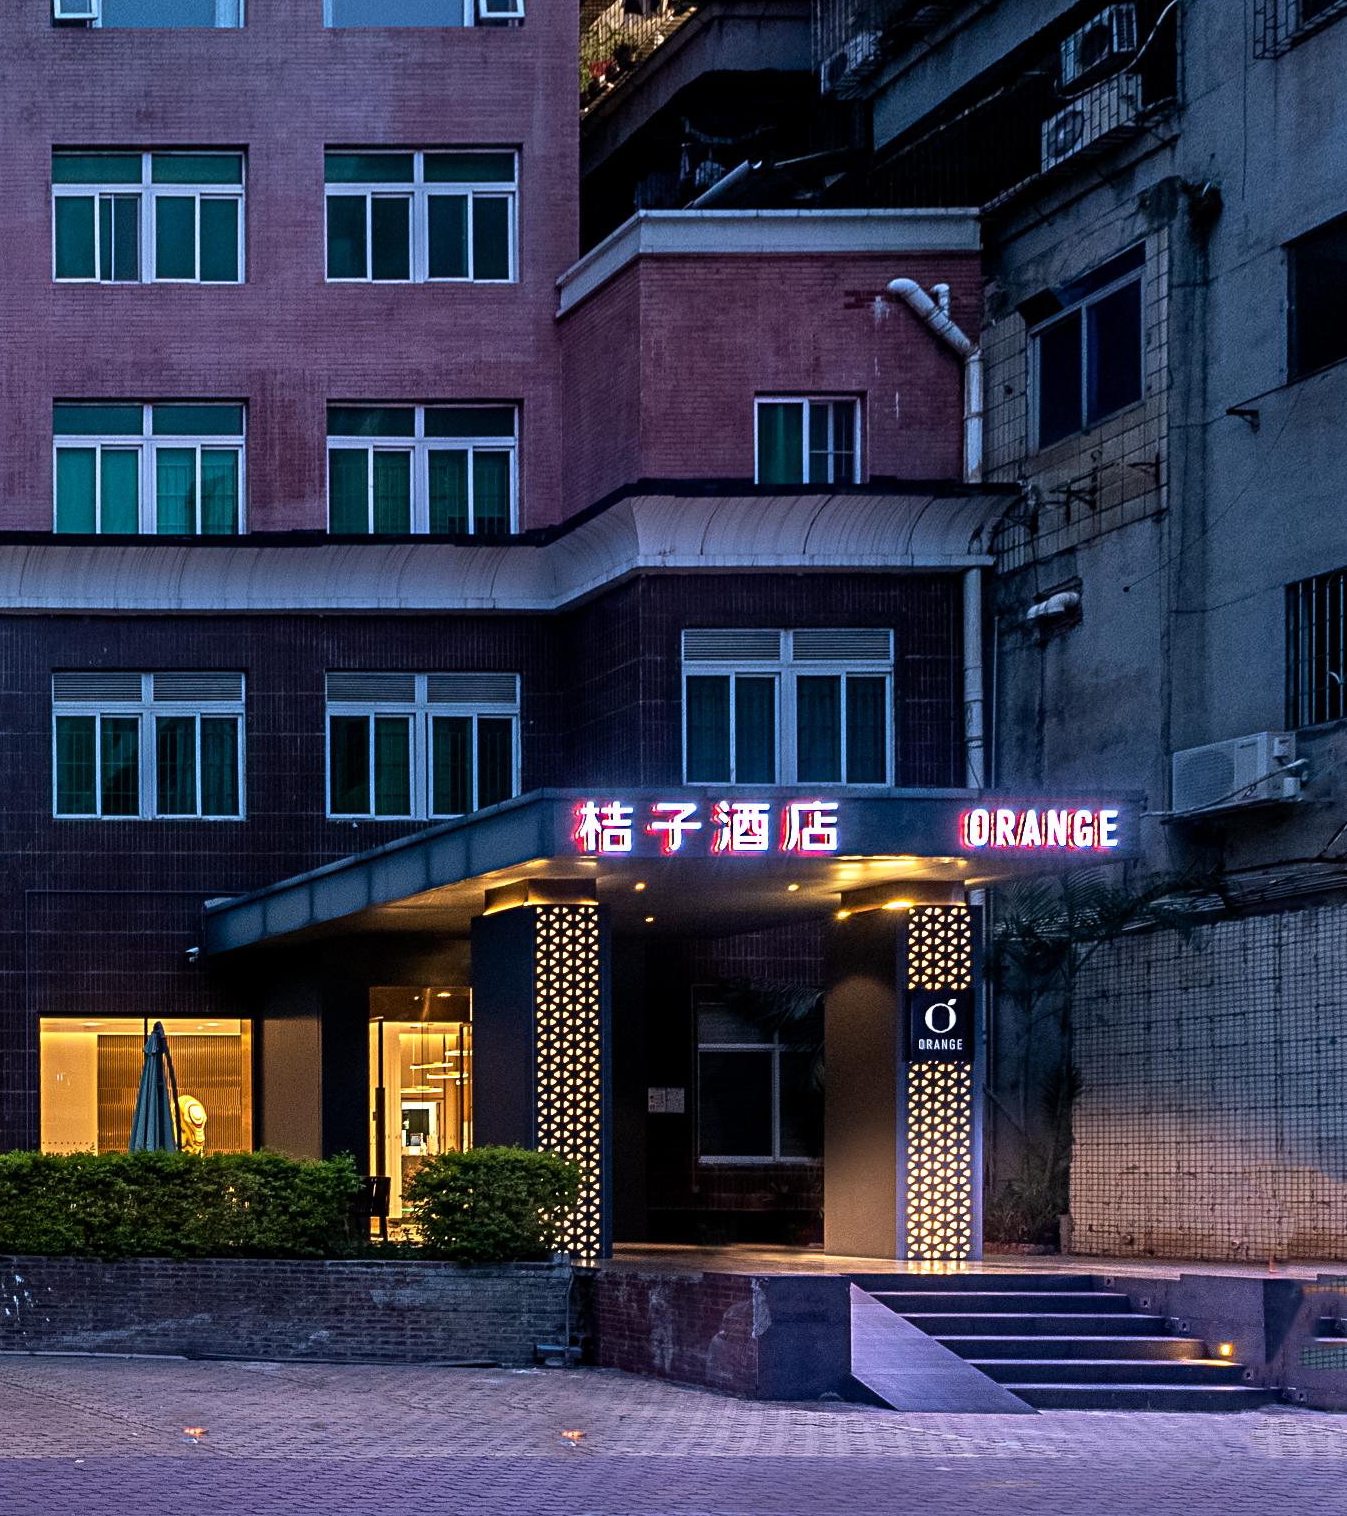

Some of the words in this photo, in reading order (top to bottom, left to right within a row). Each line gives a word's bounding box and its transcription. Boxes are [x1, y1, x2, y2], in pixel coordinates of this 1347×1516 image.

[577, 800, 839, 853] 桔子酒店
[965, 808, 1119, 848] ORANGE
[918, 1038, 963, 1051] ORANGE
